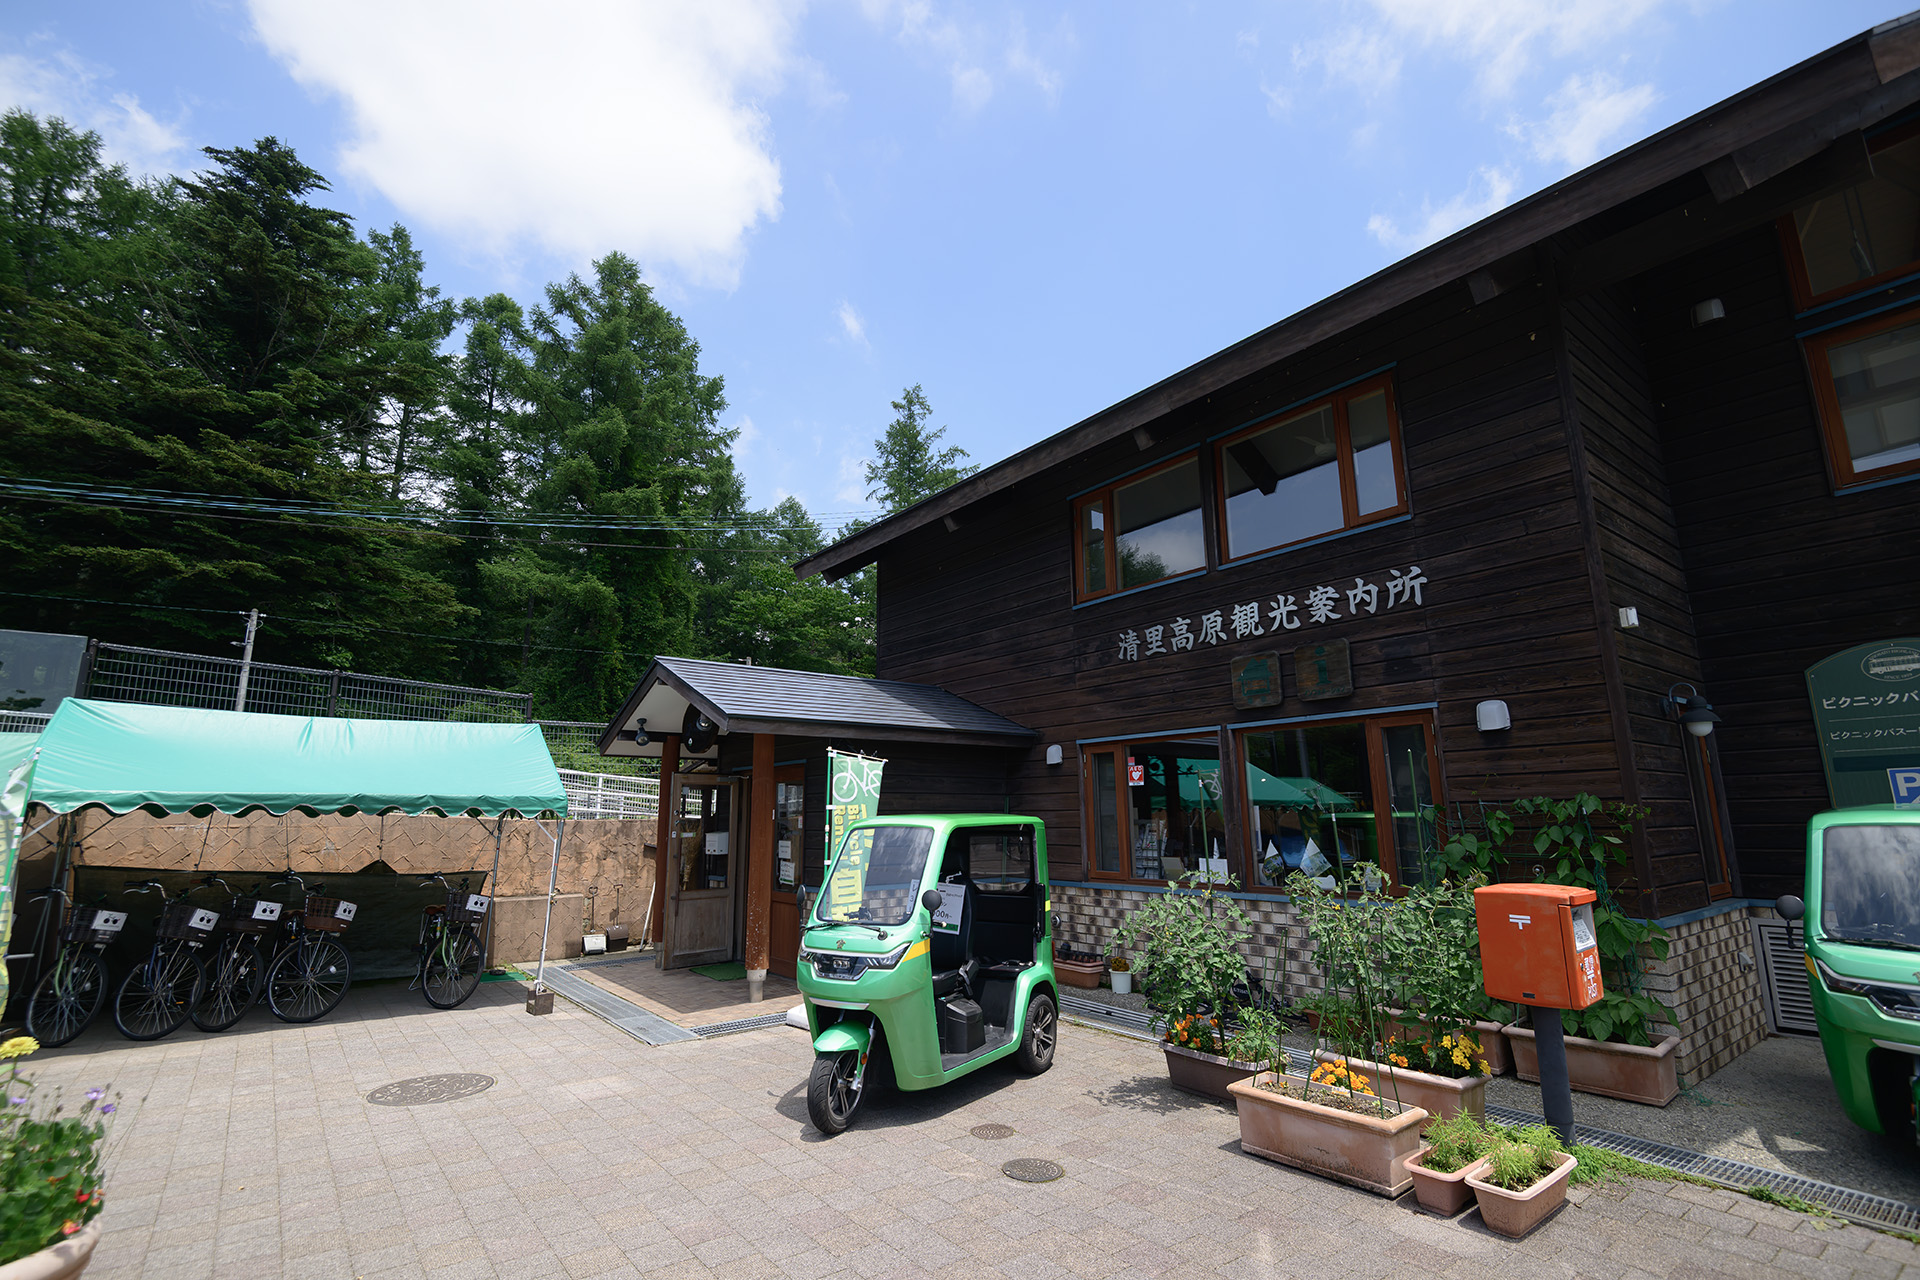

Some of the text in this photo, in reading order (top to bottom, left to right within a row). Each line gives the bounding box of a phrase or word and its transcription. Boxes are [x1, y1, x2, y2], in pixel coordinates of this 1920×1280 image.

[1118, 566, 1428, 661] 清里高原観光案内所
[1895, 772, 1920, 796] P
[847, 804, 863, 866] Biycle
